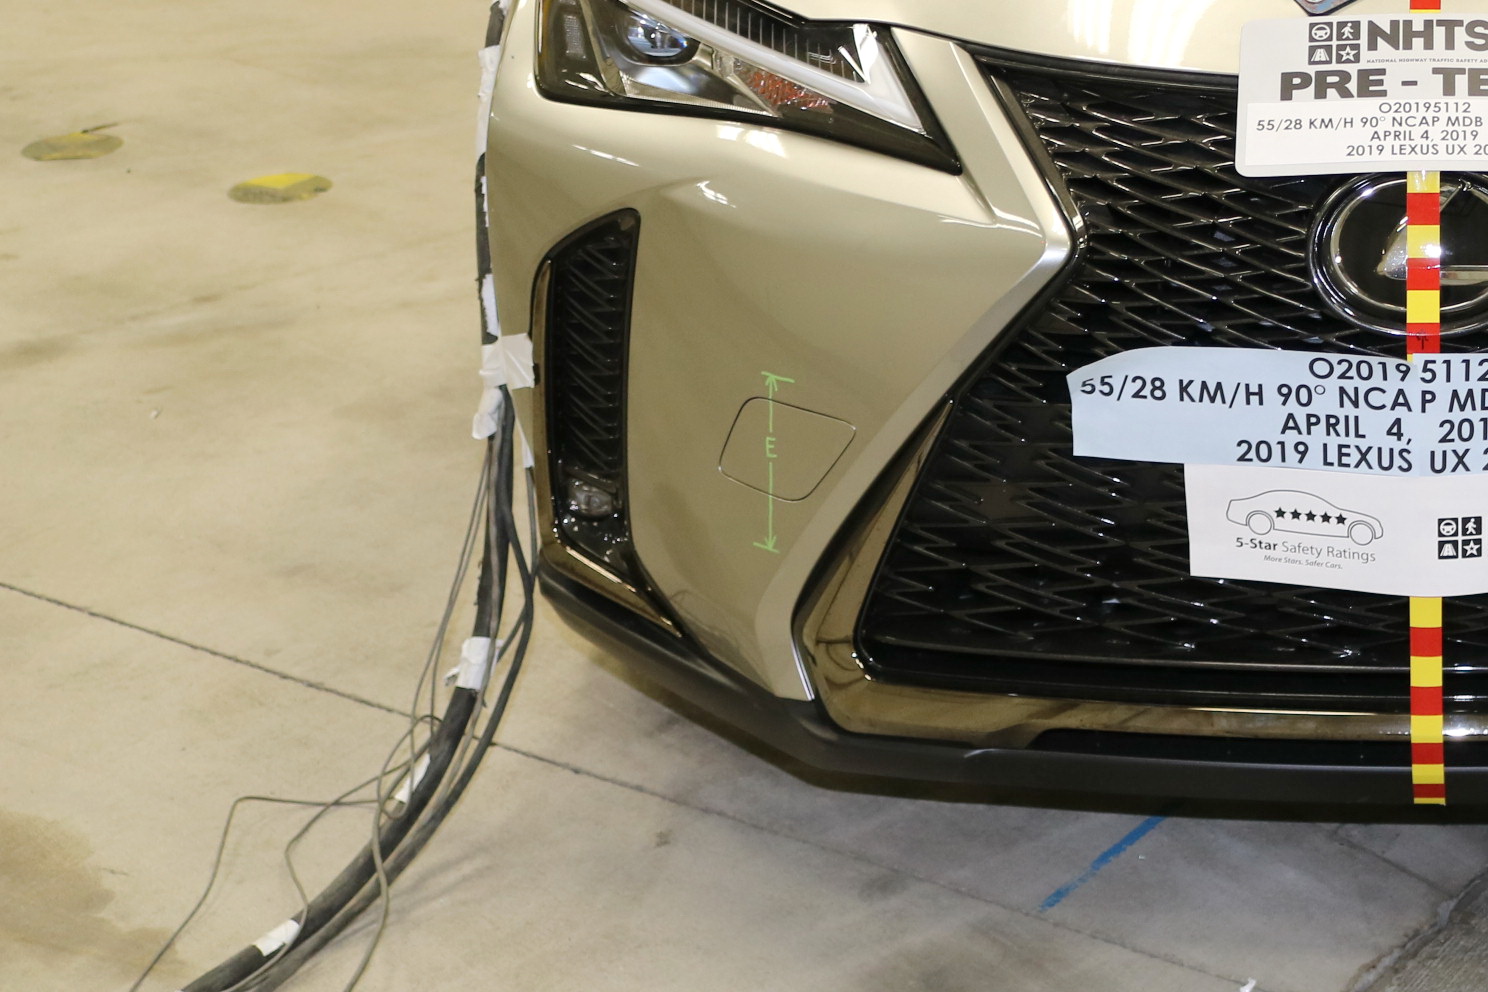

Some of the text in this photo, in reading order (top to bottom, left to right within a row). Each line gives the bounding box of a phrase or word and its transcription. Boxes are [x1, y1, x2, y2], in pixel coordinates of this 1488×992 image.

[1281, 68, 1388, 101] PRE
[1379, 102, 1471, 114] O20195112
[1257, 118, 1303, 131] 55/28
[1309, 117, 1354, 129] KM/H
[1392, 116, 1440, 127] NCAP
[1446, 116, 1483, 127] MDB
[1370, 130, 1479, 143] APRIL 4, 2019
[1346, 145, 1385, 156] 2019
[1391, 144, 1439, 155] LEXUS
[1446, 144, 1467, 155] UX
[1080, 374, 1167, 402] 55/28
[1178, 379, 1264, 409] KM/H
[1338, 386, 1437, 414] NCAP
[1280, 413, 1366, 439] APRIL
[1386, 417, 1412, 446] 4,
[766, 437, 778, 458] E
[1236, 439, 1309, 465] 2019
[1322, 443, 1413, 473] LEXUS
[1430, 448, 1471, 474] UX
[1235, 537, 1376, 564] 5-Star Safety Ratings
[1263, 555, 1343, 570] More Stars. Safer Cars.
